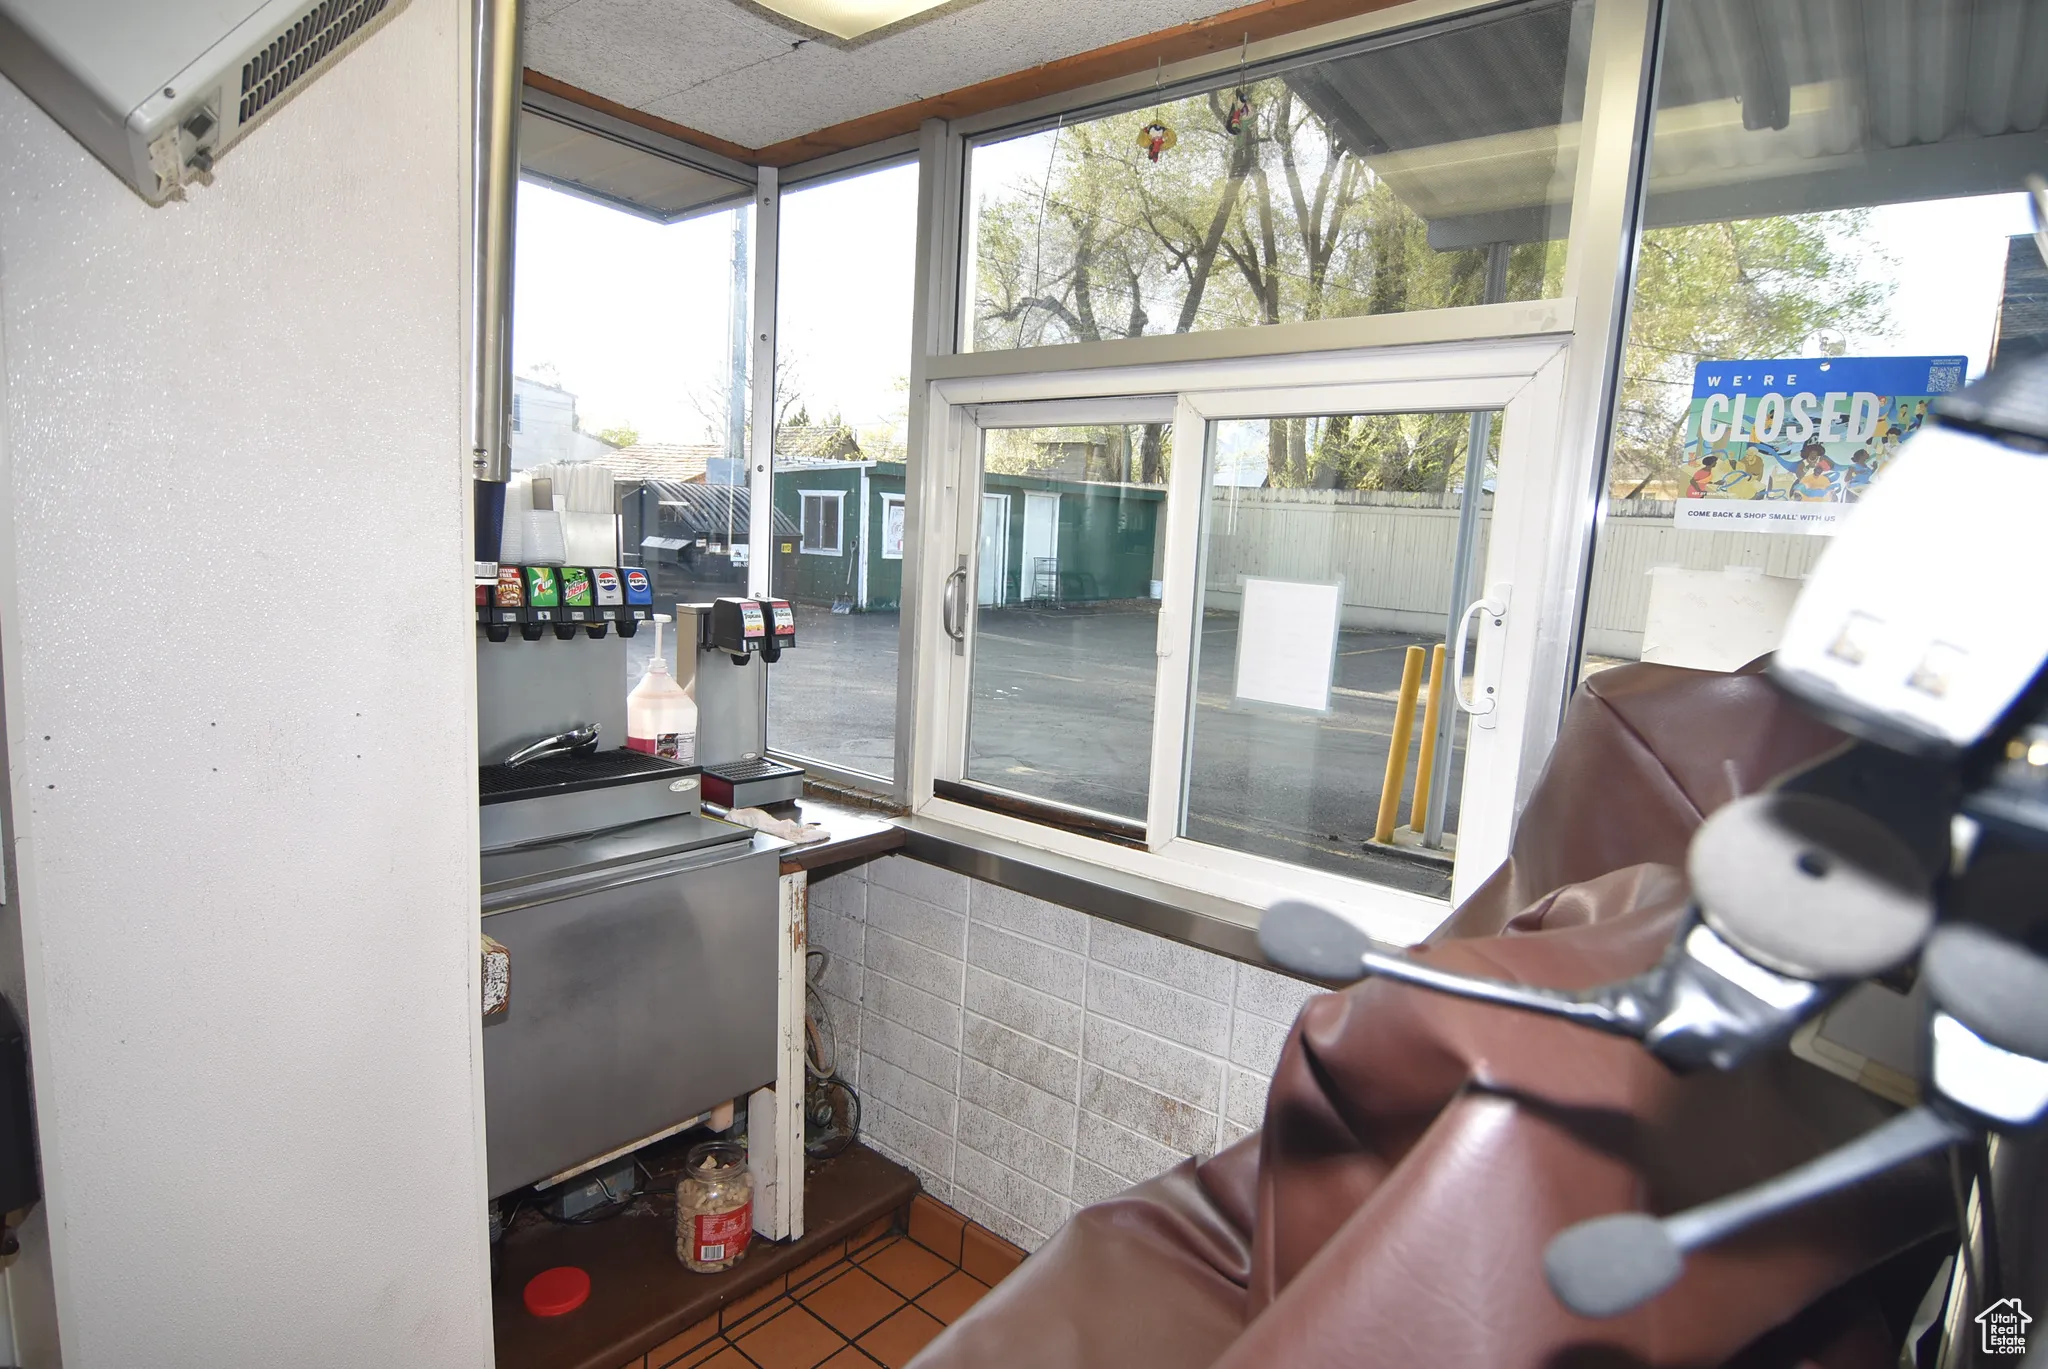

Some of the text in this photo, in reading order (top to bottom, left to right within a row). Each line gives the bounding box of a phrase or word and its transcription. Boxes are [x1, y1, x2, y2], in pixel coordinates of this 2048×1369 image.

[1707, 374, 1798, 387] WE'RE
[1700, 391, 1880, 444] CLOSED
[1687, 510, 1711, 518] COME
[497, 583, 520, 593] MUG
